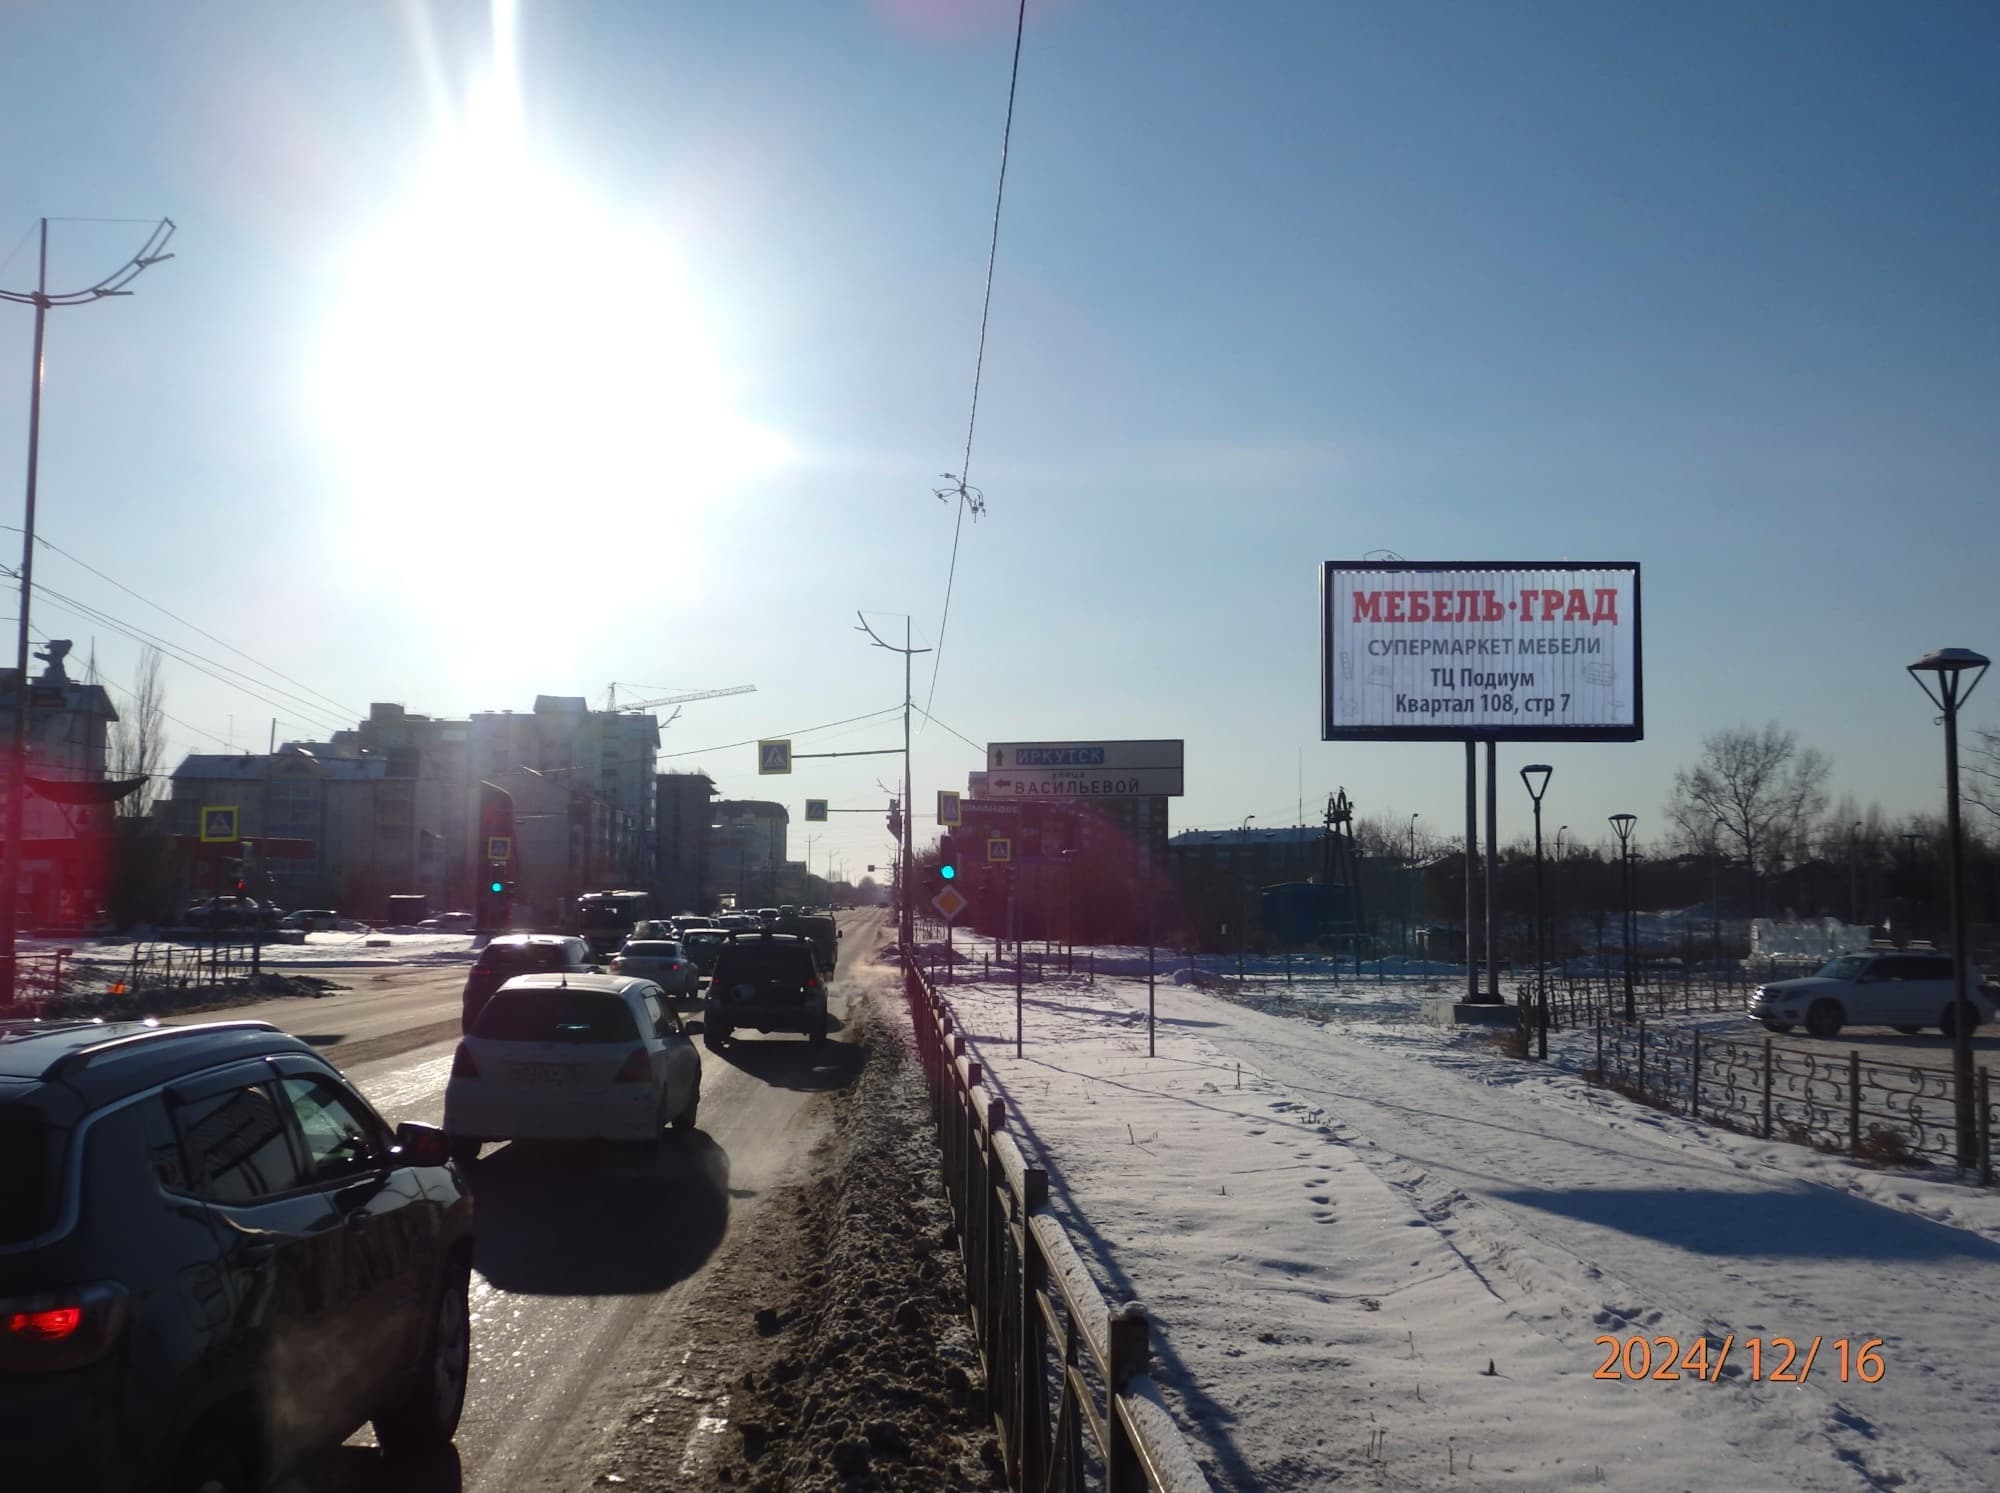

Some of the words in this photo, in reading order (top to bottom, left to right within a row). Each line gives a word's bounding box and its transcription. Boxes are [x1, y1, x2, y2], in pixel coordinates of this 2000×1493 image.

[1367, 638, 1513, 656] СУПЕРМАРКЕТ
[1518, 637, 1601, 655] МЕБЕЛИ
[1430, 668, 1455, 690] ТЦ
[1461, 669, 1535, 692] Подиум
[1396, 693, 1474, 717] Квартал
[1481, 693, 1518, 715] 108,
[1524, 698, 1555, 717] стр
[1560, 693, 1570, 712] 7
[1017, 748, 1103, 764] ИРКУТСК
[1015, 778, 1140, 794] ВАСИЛЬЕВОЙ
